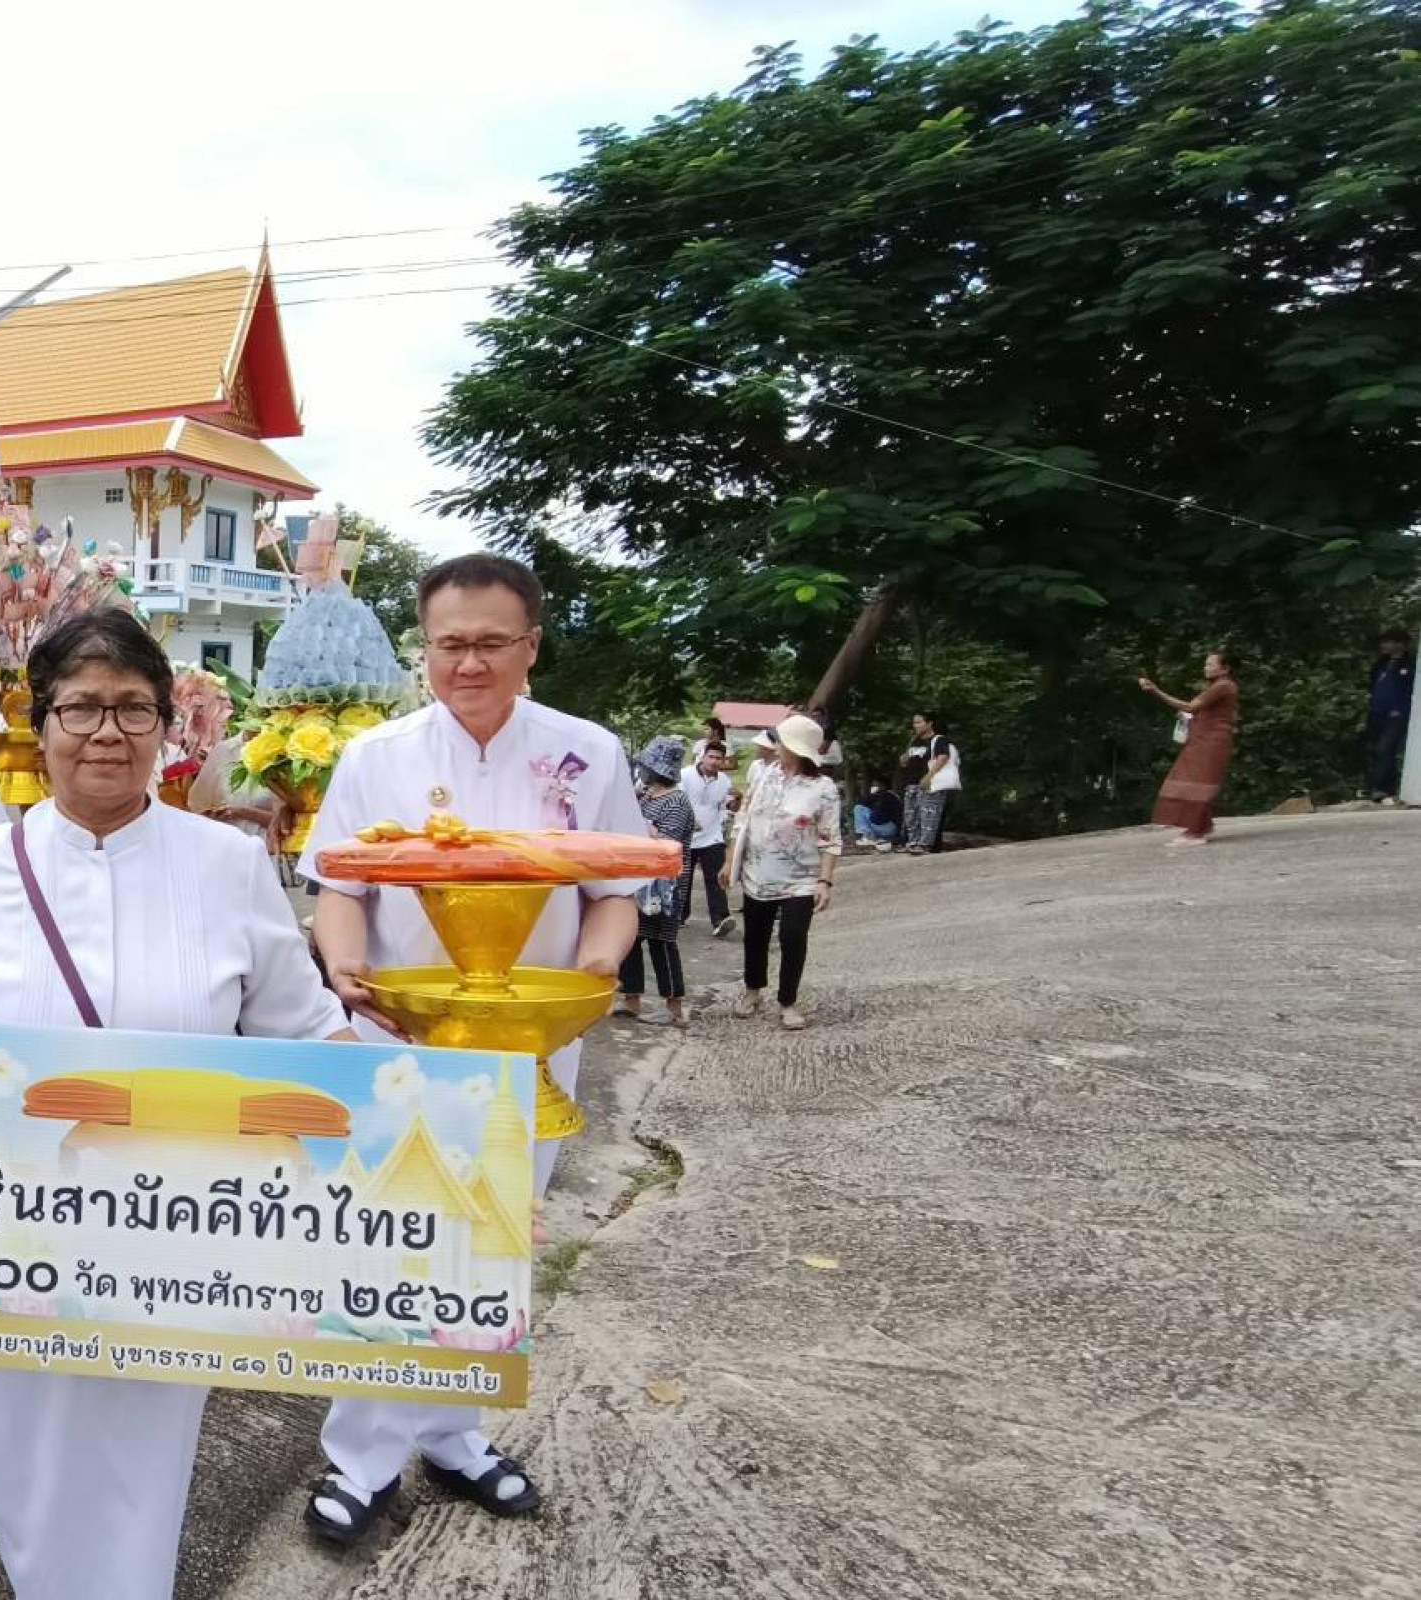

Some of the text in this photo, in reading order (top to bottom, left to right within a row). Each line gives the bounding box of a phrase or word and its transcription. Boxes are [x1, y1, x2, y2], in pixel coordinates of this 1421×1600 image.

[75, 1259, 117, 1298] วัด
[130, 1270, 324, 1315] พุทธศักราช
[341, 1278, 509, 1328] ๒๕๖๘
[232, 1357, 266, 1374] ๘๑
[277, 1351, 292, 1375] ปี
[304, 1360, 498, 1391] หลวงพ่อธัมมชโย
